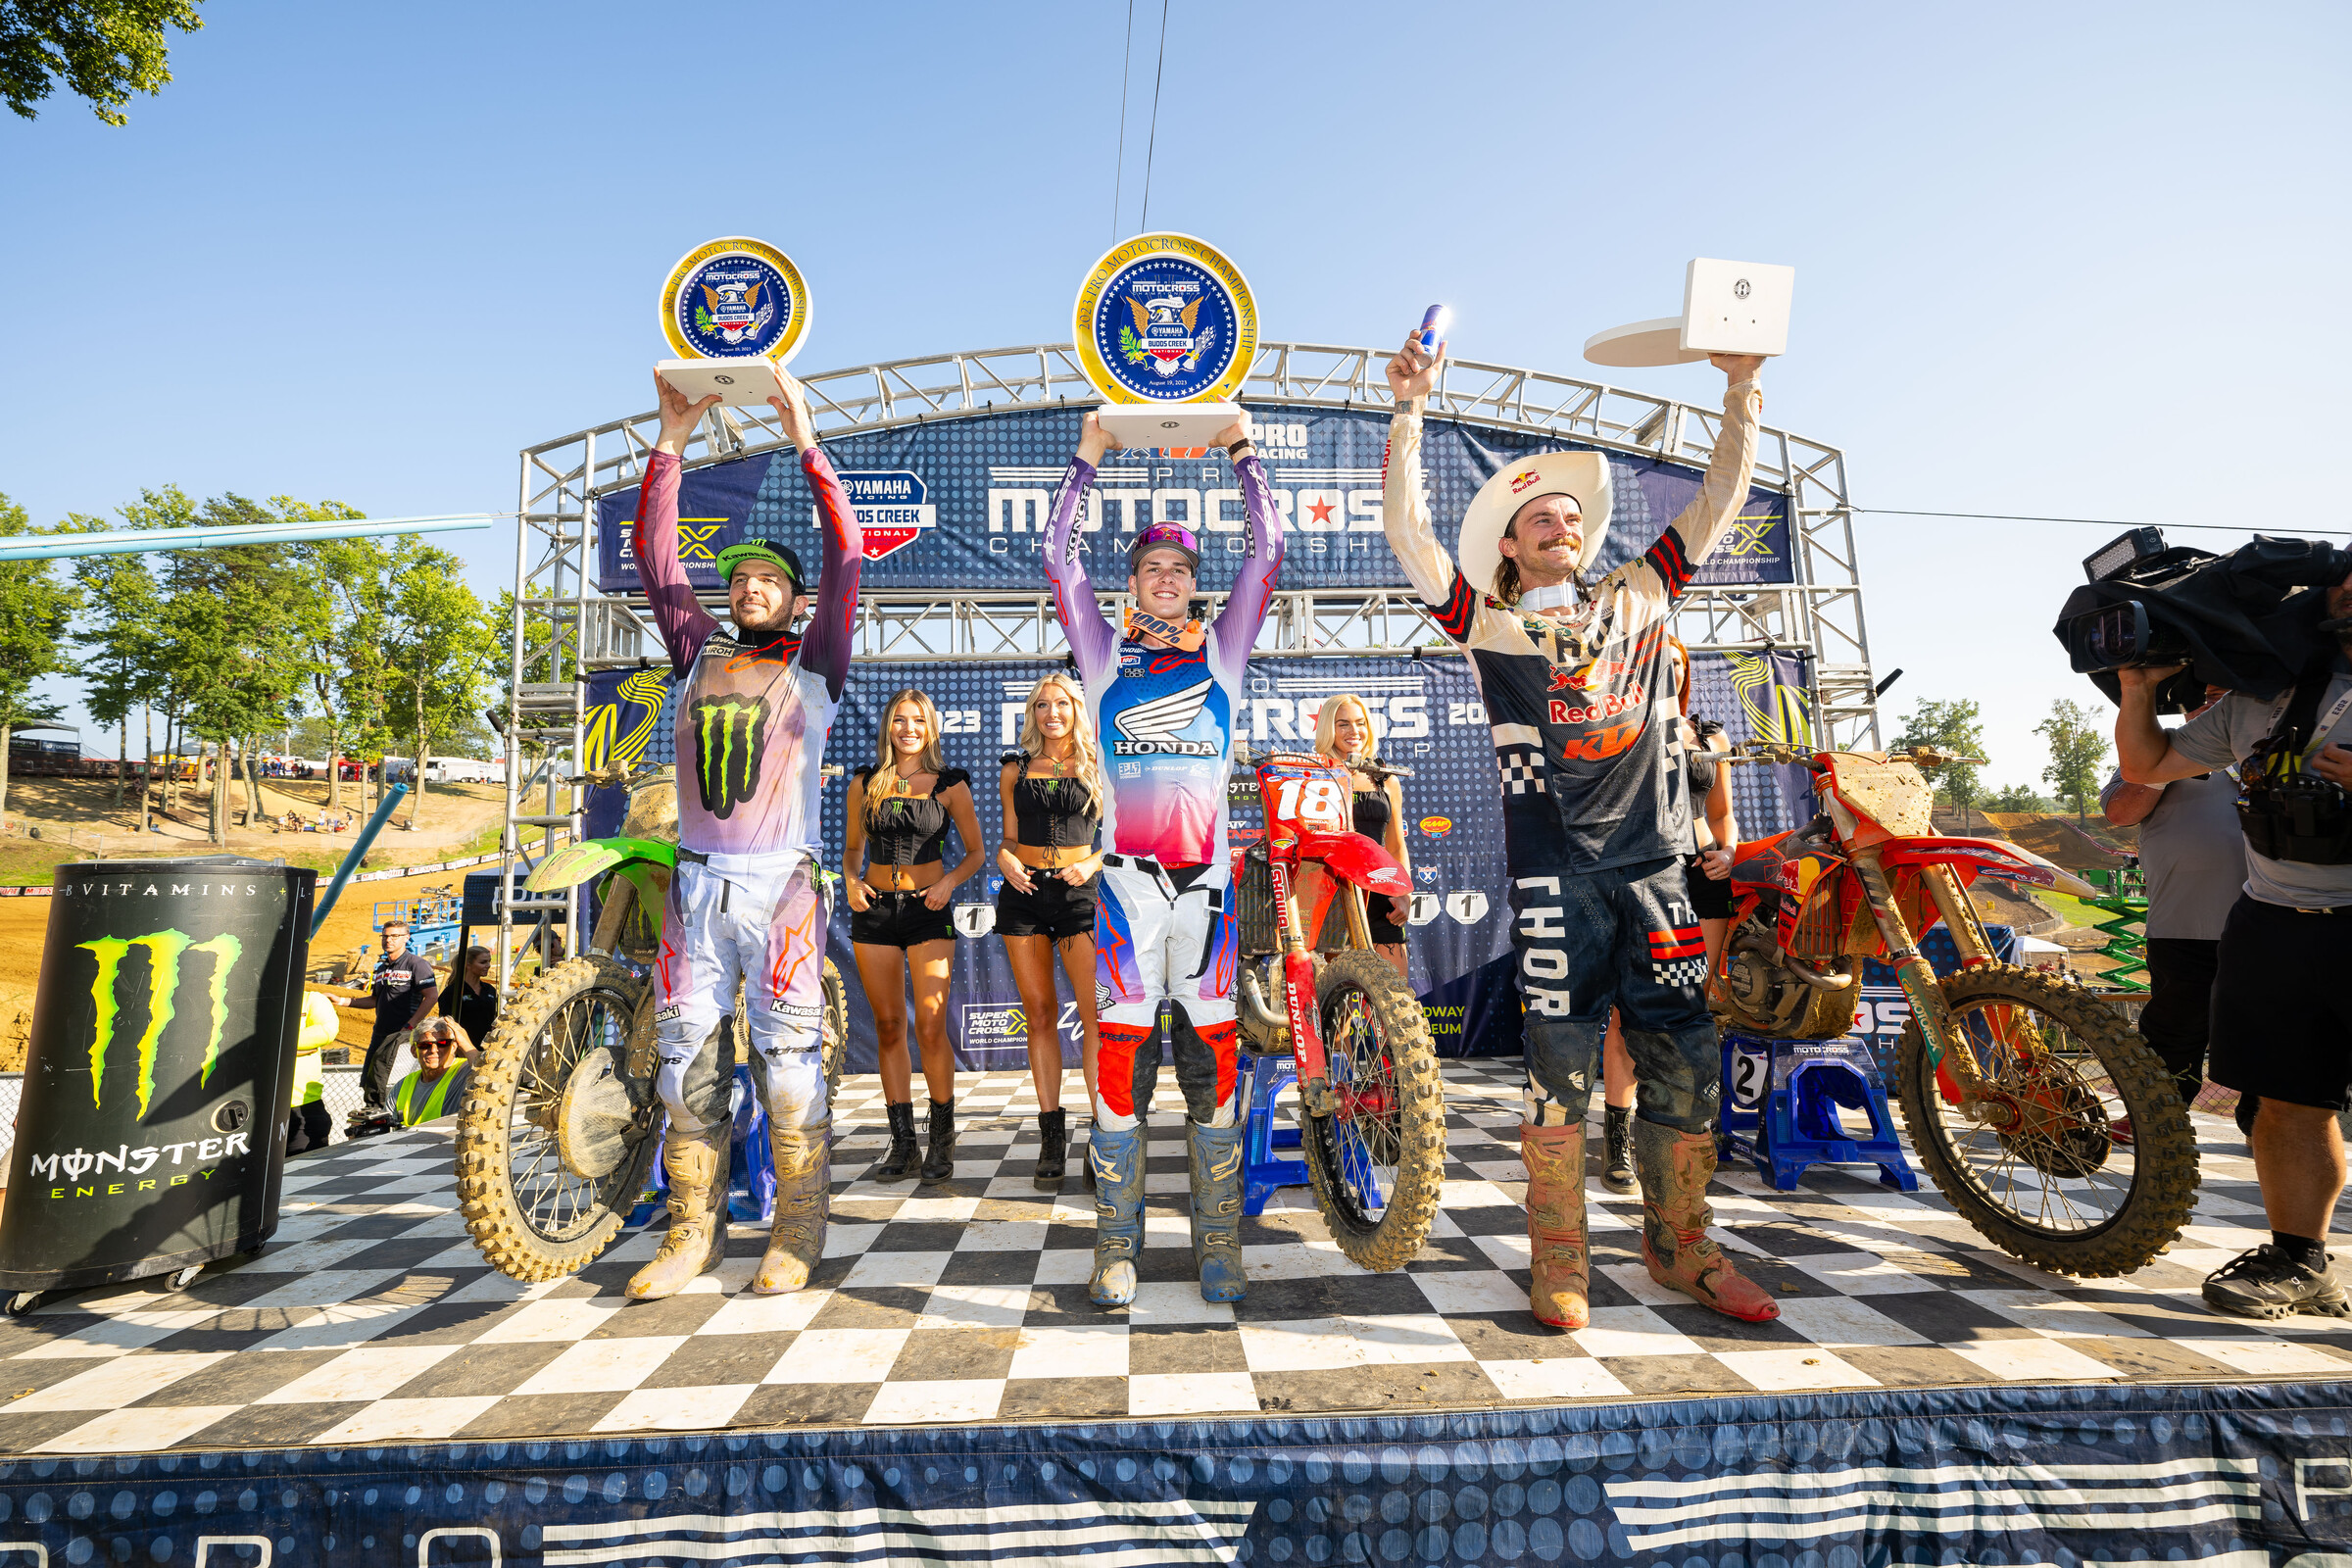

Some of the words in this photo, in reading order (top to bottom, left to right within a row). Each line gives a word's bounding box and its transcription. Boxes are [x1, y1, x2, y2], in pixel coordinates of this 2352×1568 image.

[664, 291, 675, 314] 2023
[671, 267, 690, 286] PRO
[689, 242, 761, 266] MOTOCROSS
[762, 248, 805, 325] CHAMPIONSHIP
[1079, 300, 1093, 329] 2023
[1087, 269, 1107, 296] PRO
[1106, 238, 1198, 268] MOTOCROSS
[1200, 248, 1254, 353] CHAMPIONSHIP
[1251, 424, 1307, 447] PRO
[1256, 449, 1308, 460] ACING
[855, 480, 911, 494] YAMAHA
[1512, 483, 1527, 494] Red
[1526, 475, 1541, 487] Bull
[877, 510, 920, 522] CREEK
[1066, 482, 1090, 565] HONDA
[722, 552, 776, 562] Kawasaki
[1130, 612, 1184, 644] 100%
[1547, 697, 1601, 724] Red
[1601, 680, 1647, 718] Bull
[1113, 741, 1218, 756] HONDA
[1277, 779, 1344, 821] 18
[82, 884, 257, 897] VITAMINS
[1272, 862, 1290, 930] SHOWA
[1369, 878, 1407, 887] HONDA
[1780, 919, 1791, 930] KTM
[1516, 876, 1570, 1016] THOR
[968, 1011, 1009, 1020] SUPER
[968, 1026, 1007, 1035] CROSS
[1288, 982, 1307, 1062] DUNLOP
[1909, 995, 1942, 1053] MOTOREX
[1736, 1055, 1755, 1098] 2
[29, 1131, 251, 1182] MONSTER
[51, 1168, 217, 1200] ENERGY
